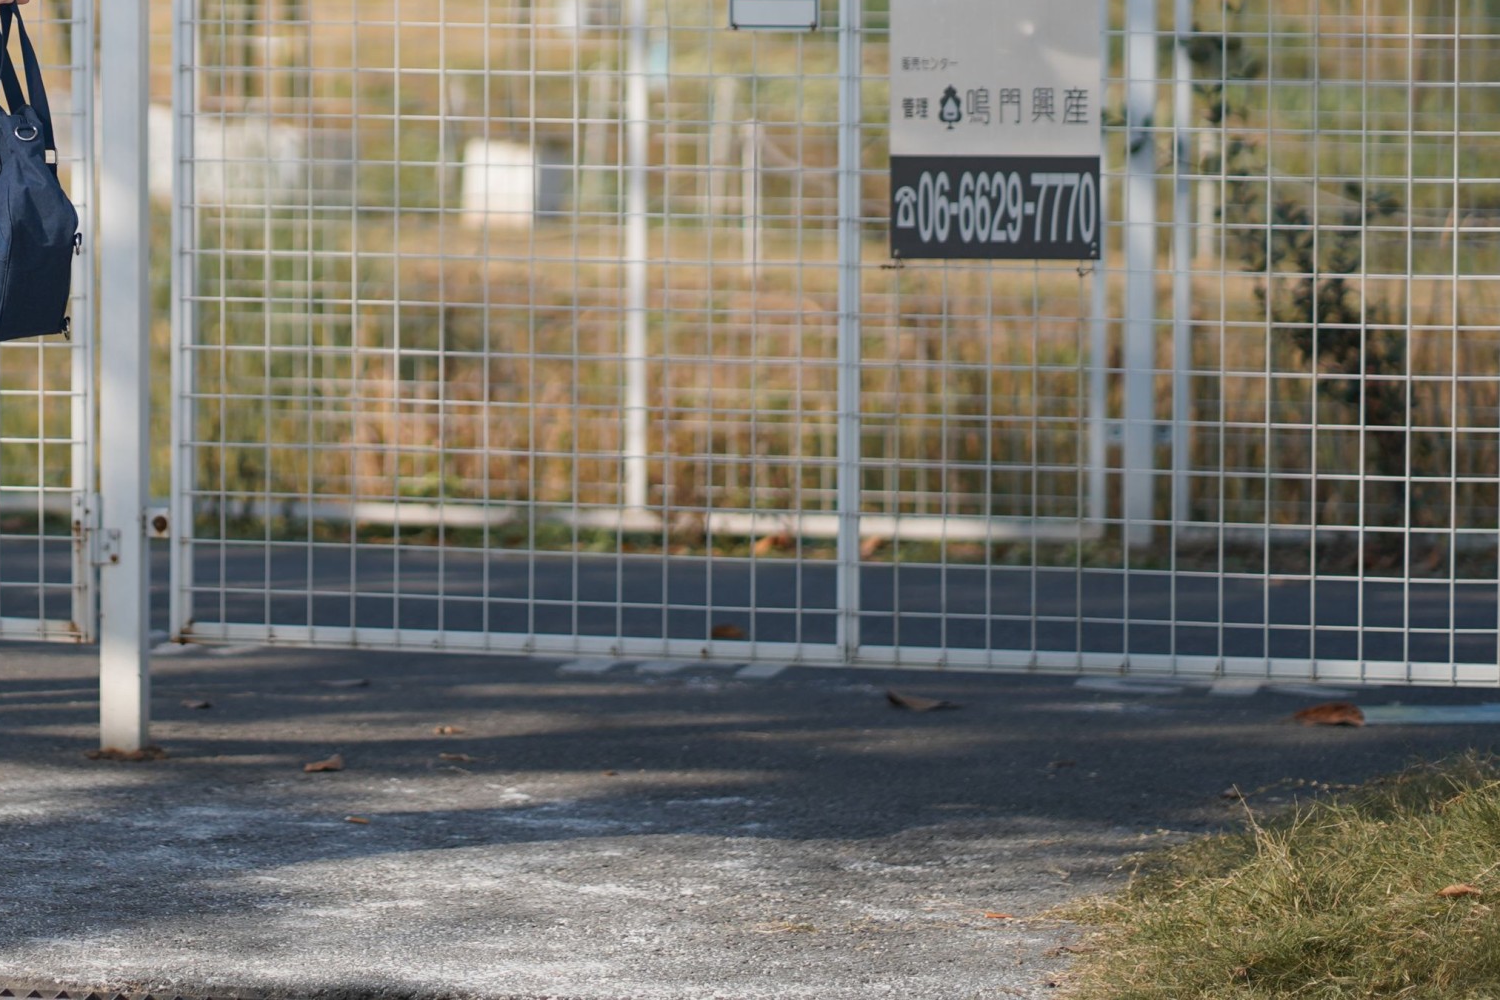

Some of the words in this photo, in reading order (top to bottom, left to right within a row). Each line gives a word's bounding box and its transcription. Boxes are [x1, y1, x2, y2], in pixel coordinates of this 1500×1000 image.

[902, 97, 929, 119] 管理
[966, 85, 1090, 126] 鳴門興産
[917, 170, 1097, 244] 06-6629-7770
